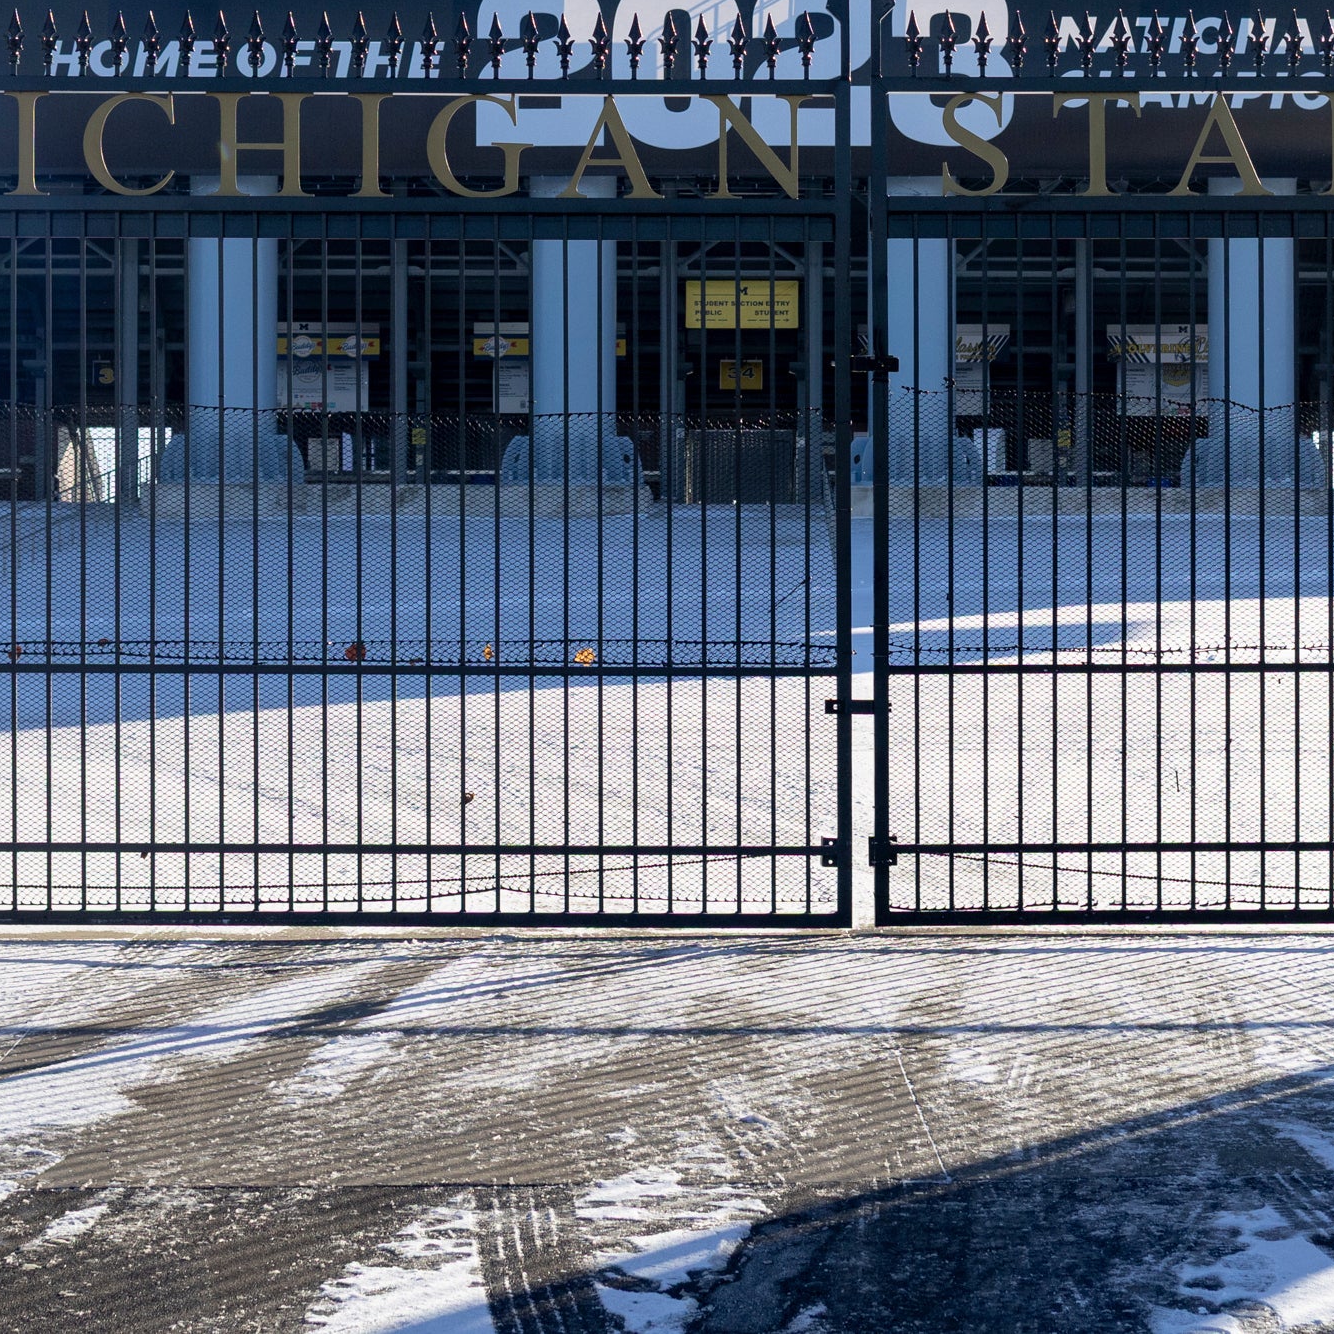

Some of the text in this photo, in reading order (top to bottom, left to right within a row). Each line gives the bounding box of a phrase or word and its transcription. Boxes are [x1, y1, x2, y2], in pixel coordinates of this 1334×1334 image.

[45, 40, 224, 78] HOME
[236, 40, 314, 78] OF
[329, 40, 441, 78] THE
[1115, 343, 1191, 354] OLVRINE
[727, 367, 755, 379] 34
